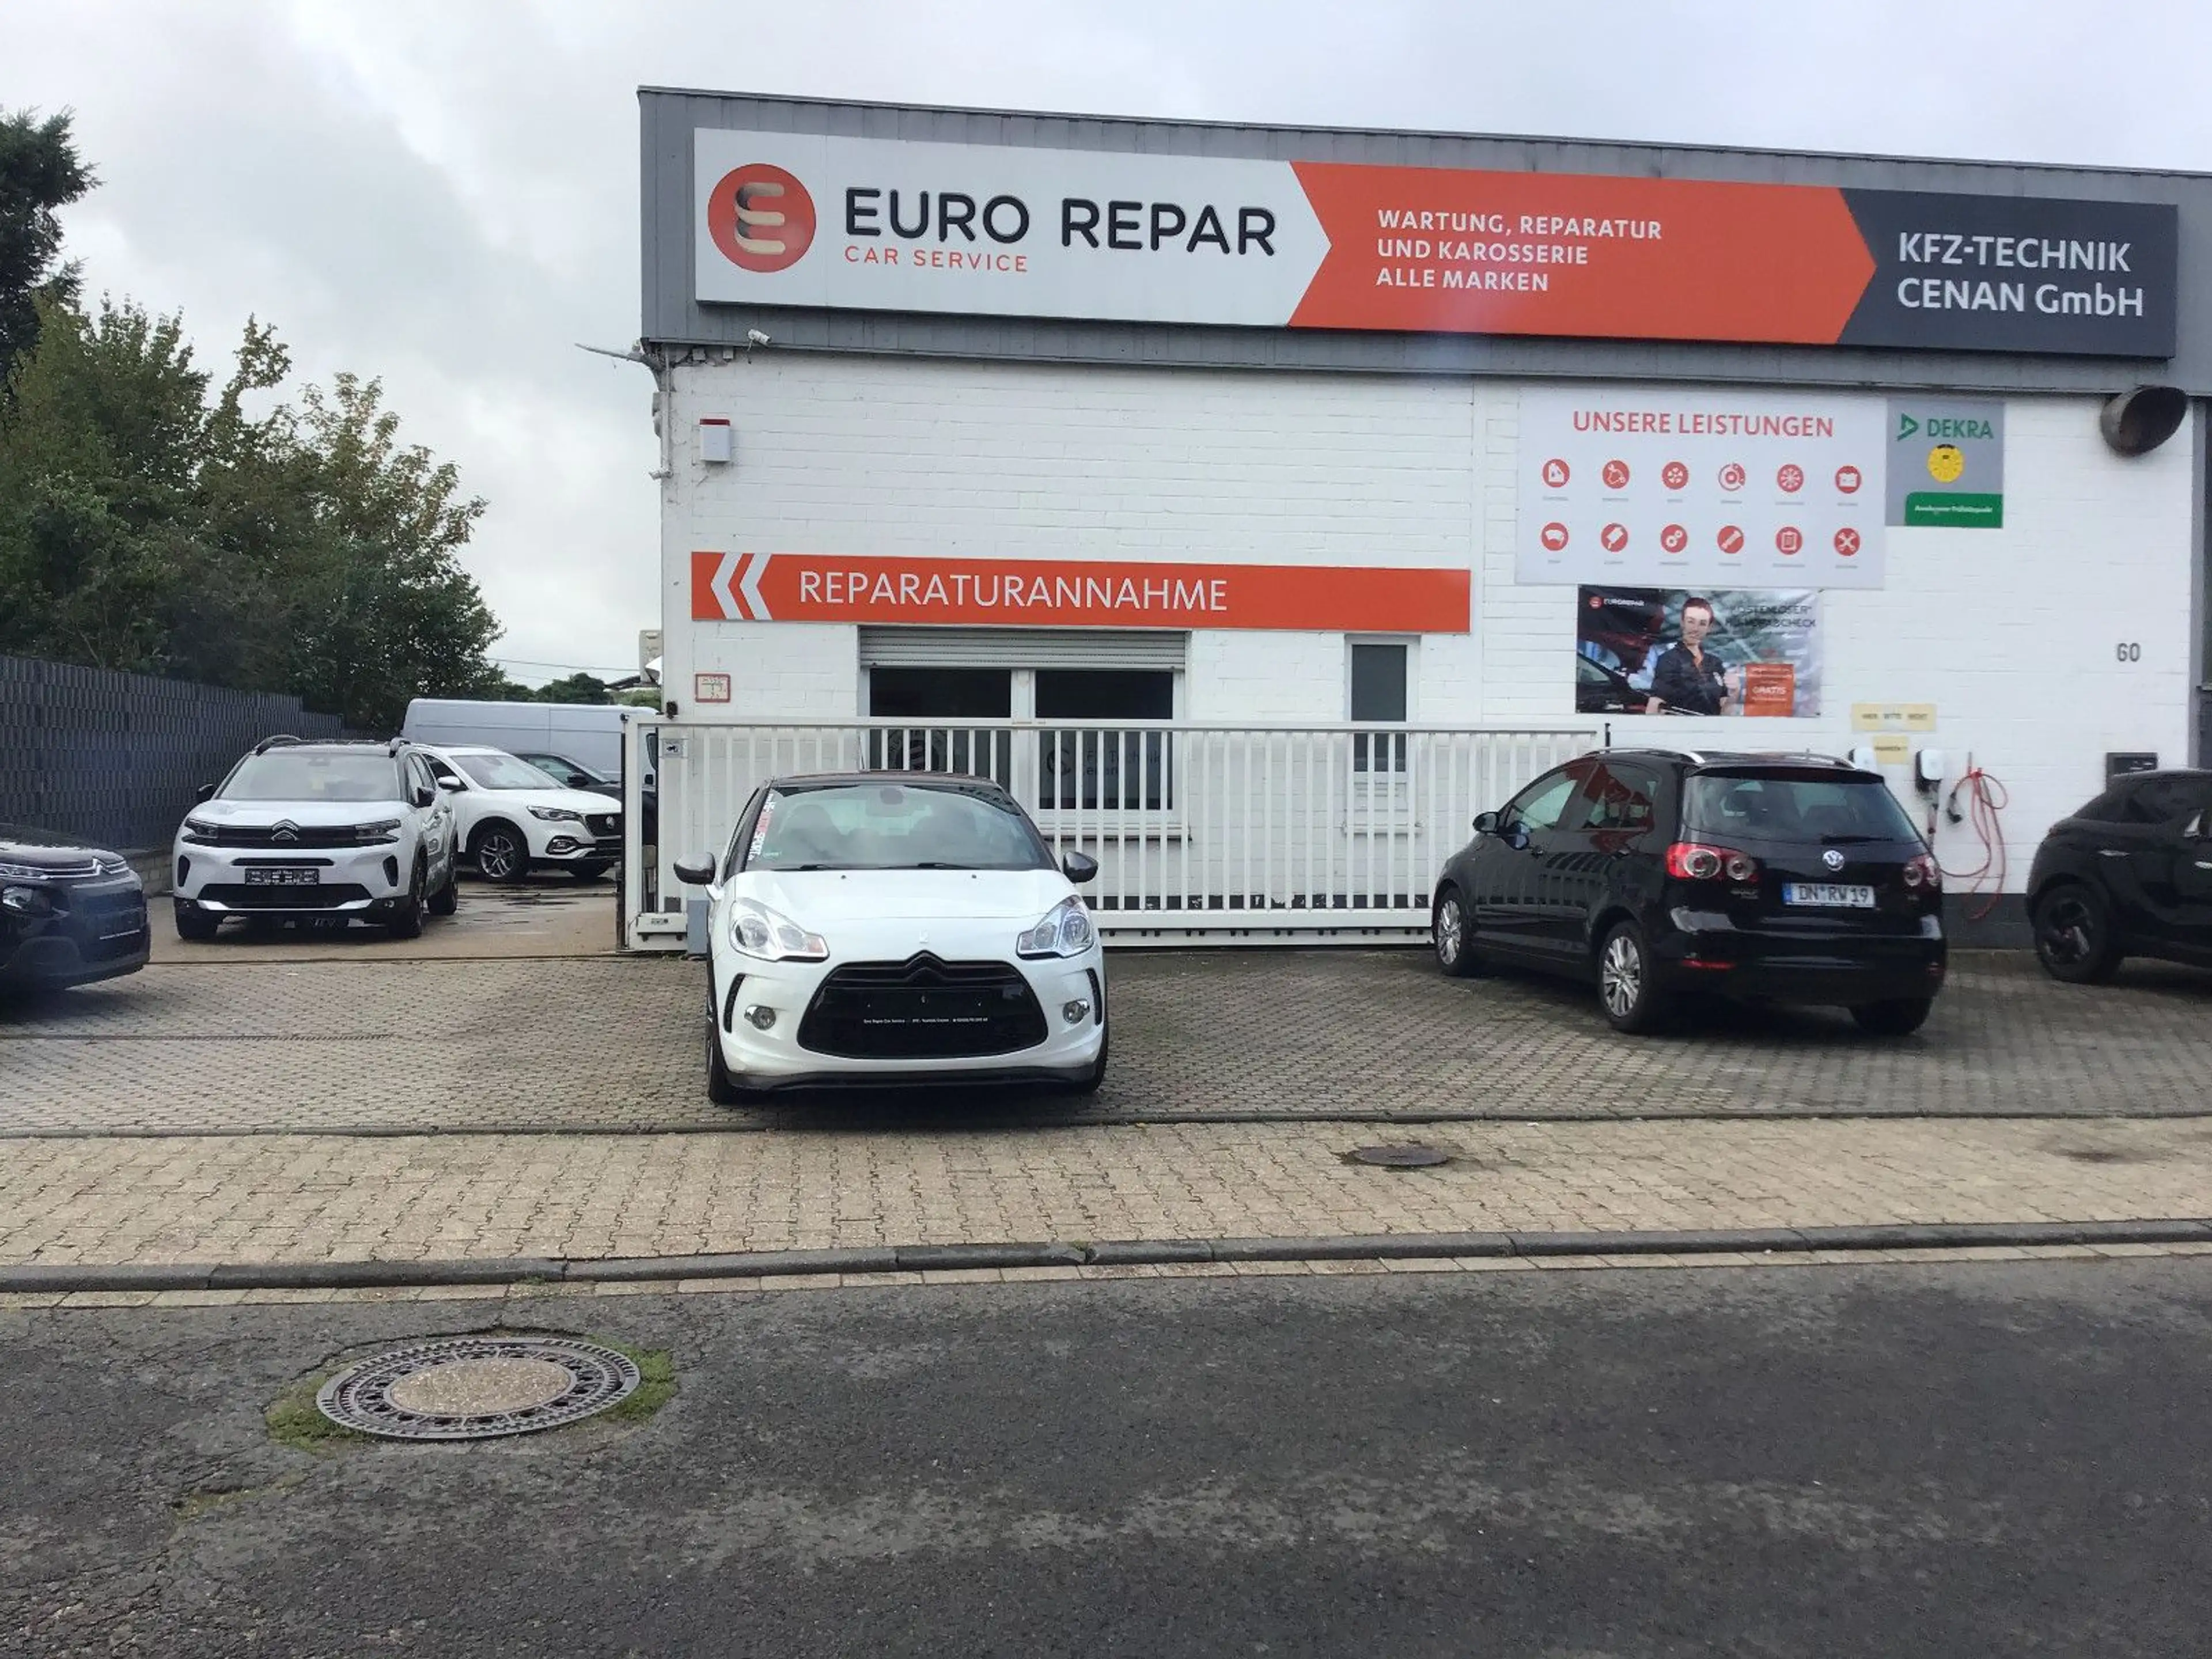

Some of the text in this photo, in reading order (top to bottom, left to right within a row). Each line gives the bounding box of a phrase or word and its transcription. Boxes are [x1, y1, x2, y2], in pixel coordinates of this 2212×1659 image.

[846, 187, 1275, 256] EURO REPAR
[1378, 210, 1661, 239] WARTUNG, REPARATUR
[844, 246, 1029, 273] CAR SERVICE
[1378, 239, 1588, 264] UND KAROSSERIE
[1899, 232, 2131, 272] KFZ-TECHNIK
[1376, 267, 1548, 291] ALLE MARKEN
[1897, 278, 2143, 316] CENAN GmbH
[1573, 411, 1833, 437] UNSERE LEISTUNGEN
[1927, 418, 1994, 439] DEKRA
[800, 570, 1228, 611] REPARATURANNAHME
[2116, 642, 2141, 662] 60
[1798, 885, 1819, 900] DN
